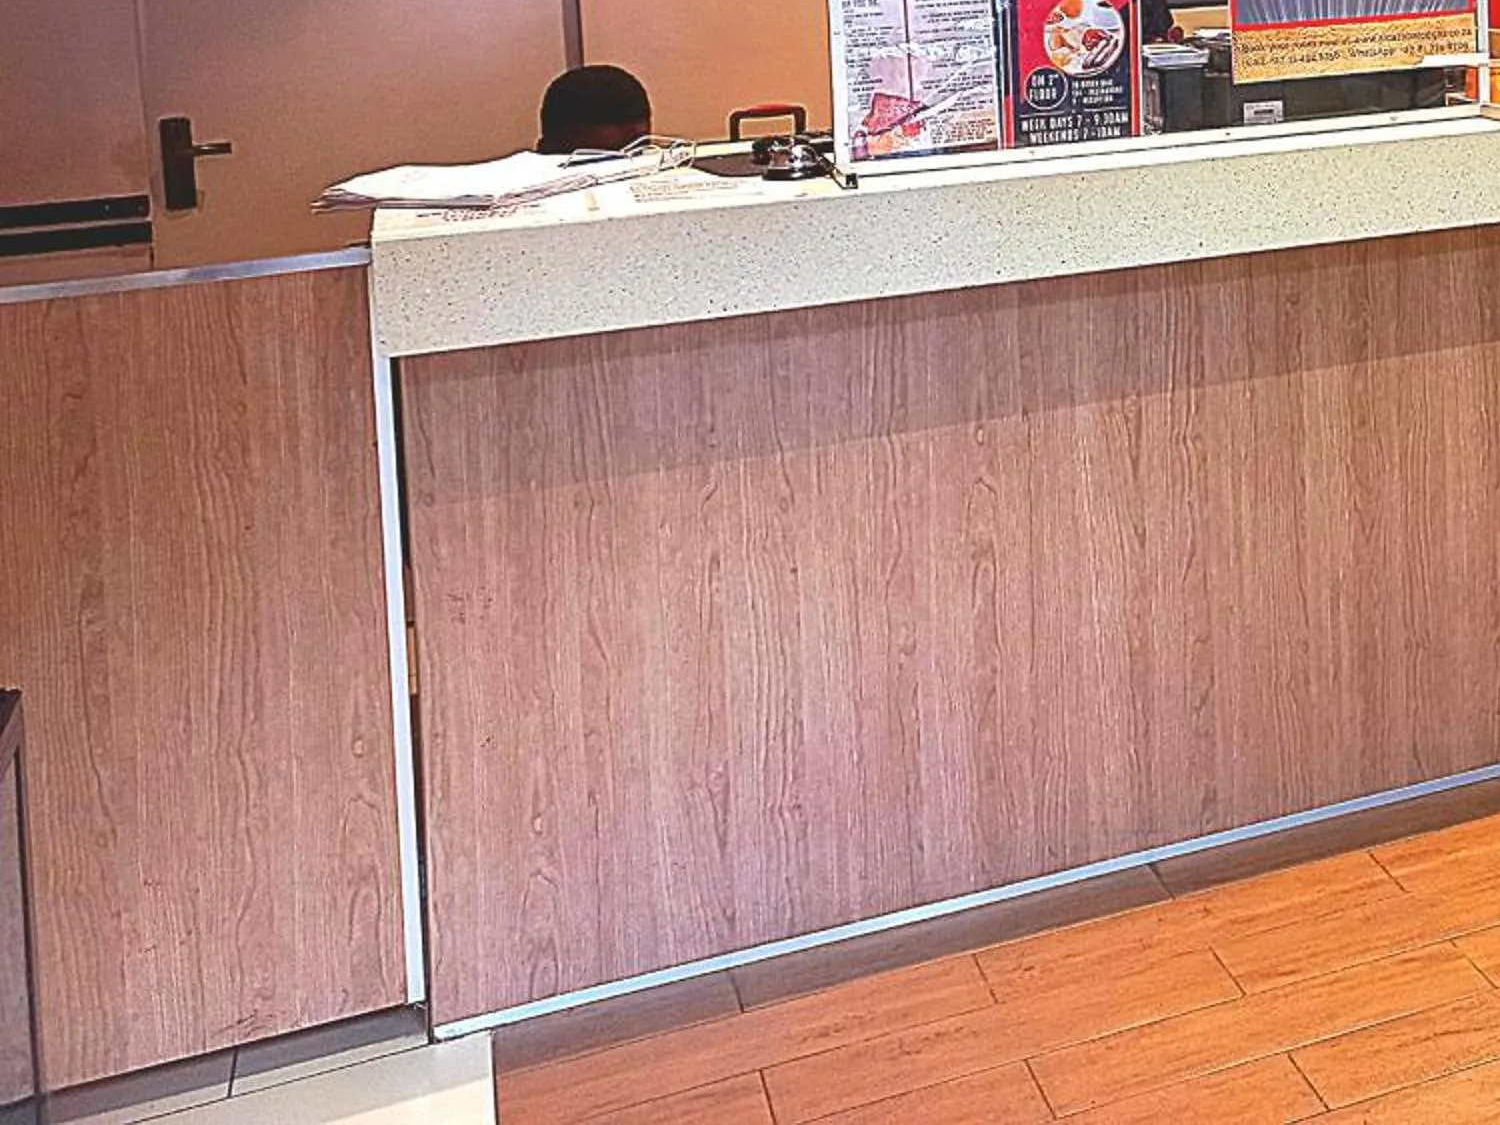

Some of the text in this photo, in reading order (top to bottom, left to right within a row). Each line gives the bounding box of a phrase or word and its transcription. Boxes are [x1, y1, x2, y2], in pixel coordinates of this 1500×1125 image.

[1021, 118, 1046, 131] WEEK
[1049, 116, 1073, 130] DAYS
[1030, 128, 1079, 144] WEEKENDS
